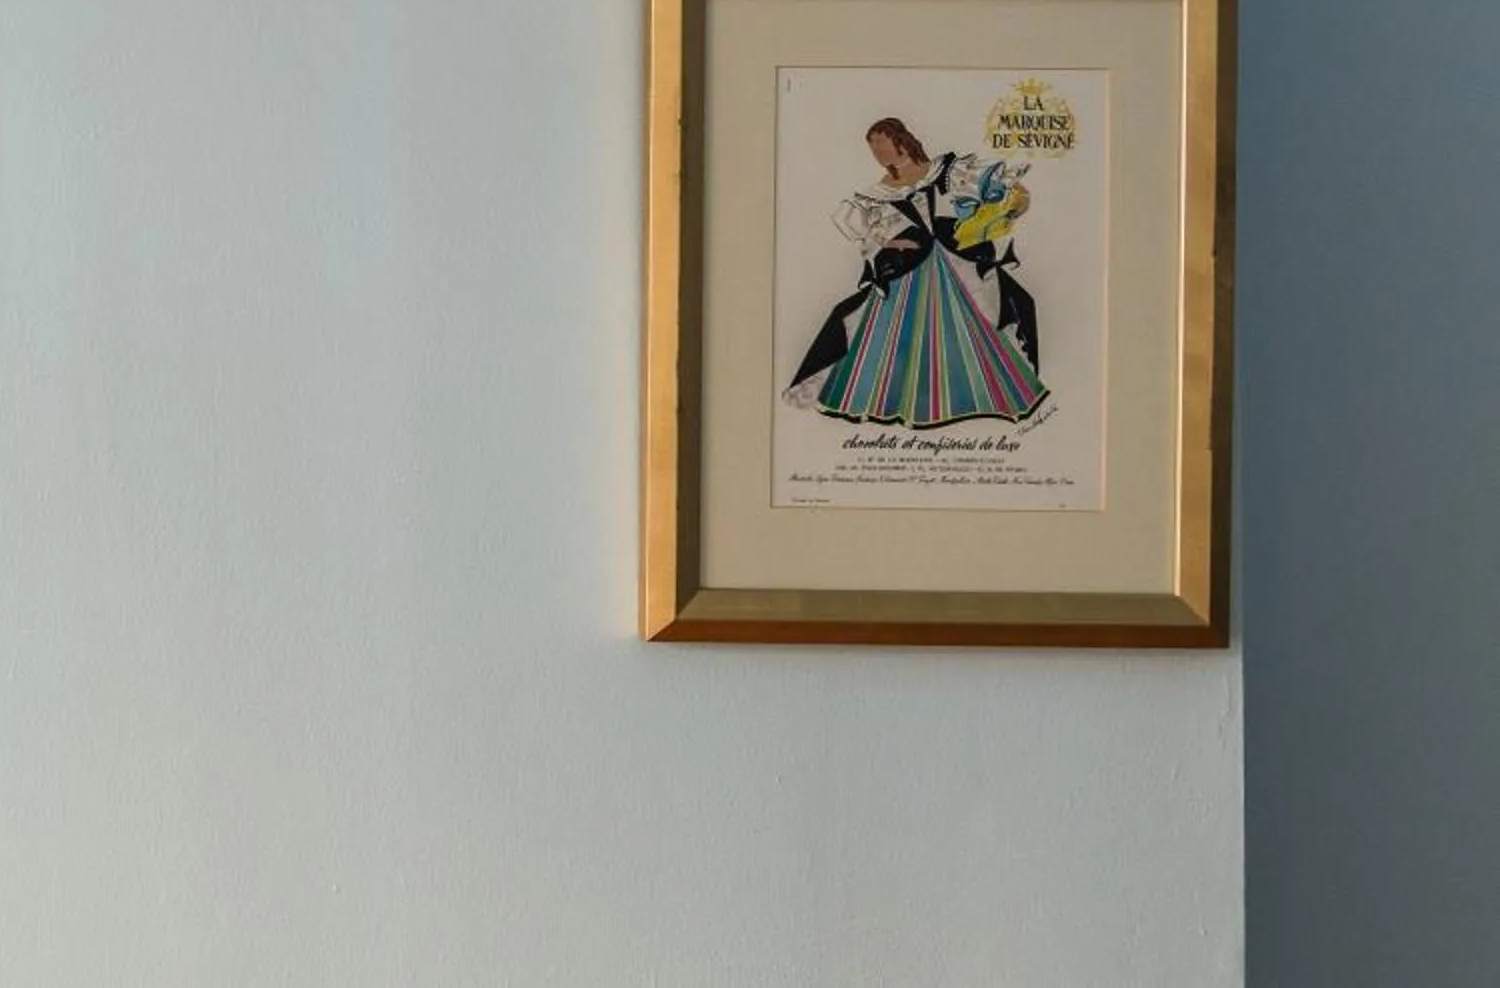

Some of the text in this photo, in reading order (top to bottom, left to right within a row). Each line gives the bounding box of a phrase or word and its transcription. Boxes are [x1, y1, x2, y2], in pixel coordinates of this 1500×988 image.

[1023, 95, 1045, 111] LA
[997, 114, 1071, 131] MARQUISE
[992, 133, 1012, 149] DE
